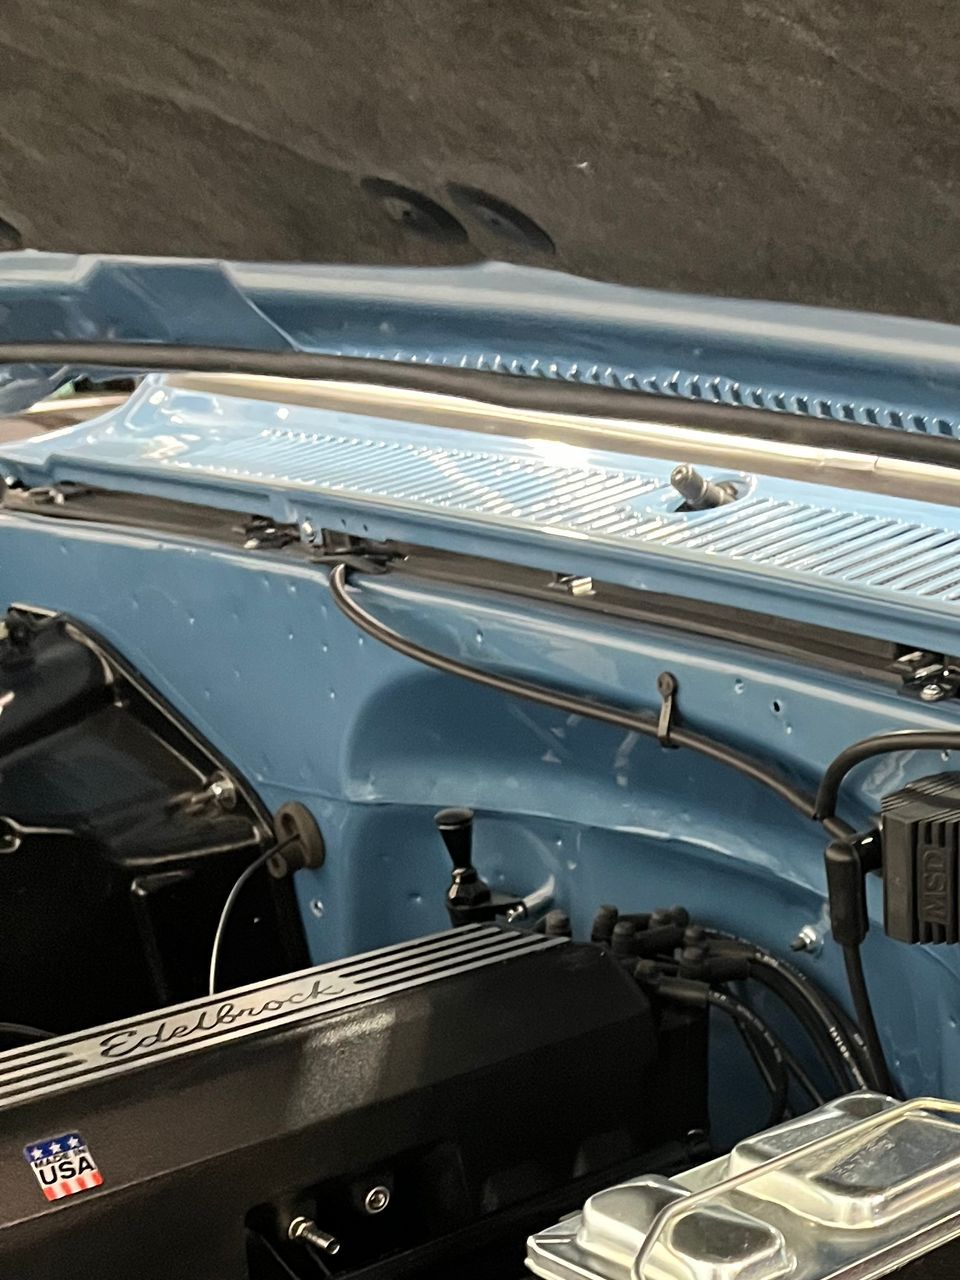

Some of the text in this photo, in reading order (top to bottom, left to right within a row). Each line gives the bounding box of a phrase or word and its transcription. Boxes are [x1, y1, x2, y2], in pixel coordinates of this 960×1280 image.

[922, 850, 946, 918] MSD
[100, 980, 345, 1058] Edelbrock
[39, 1156, 94, 1185] USA
